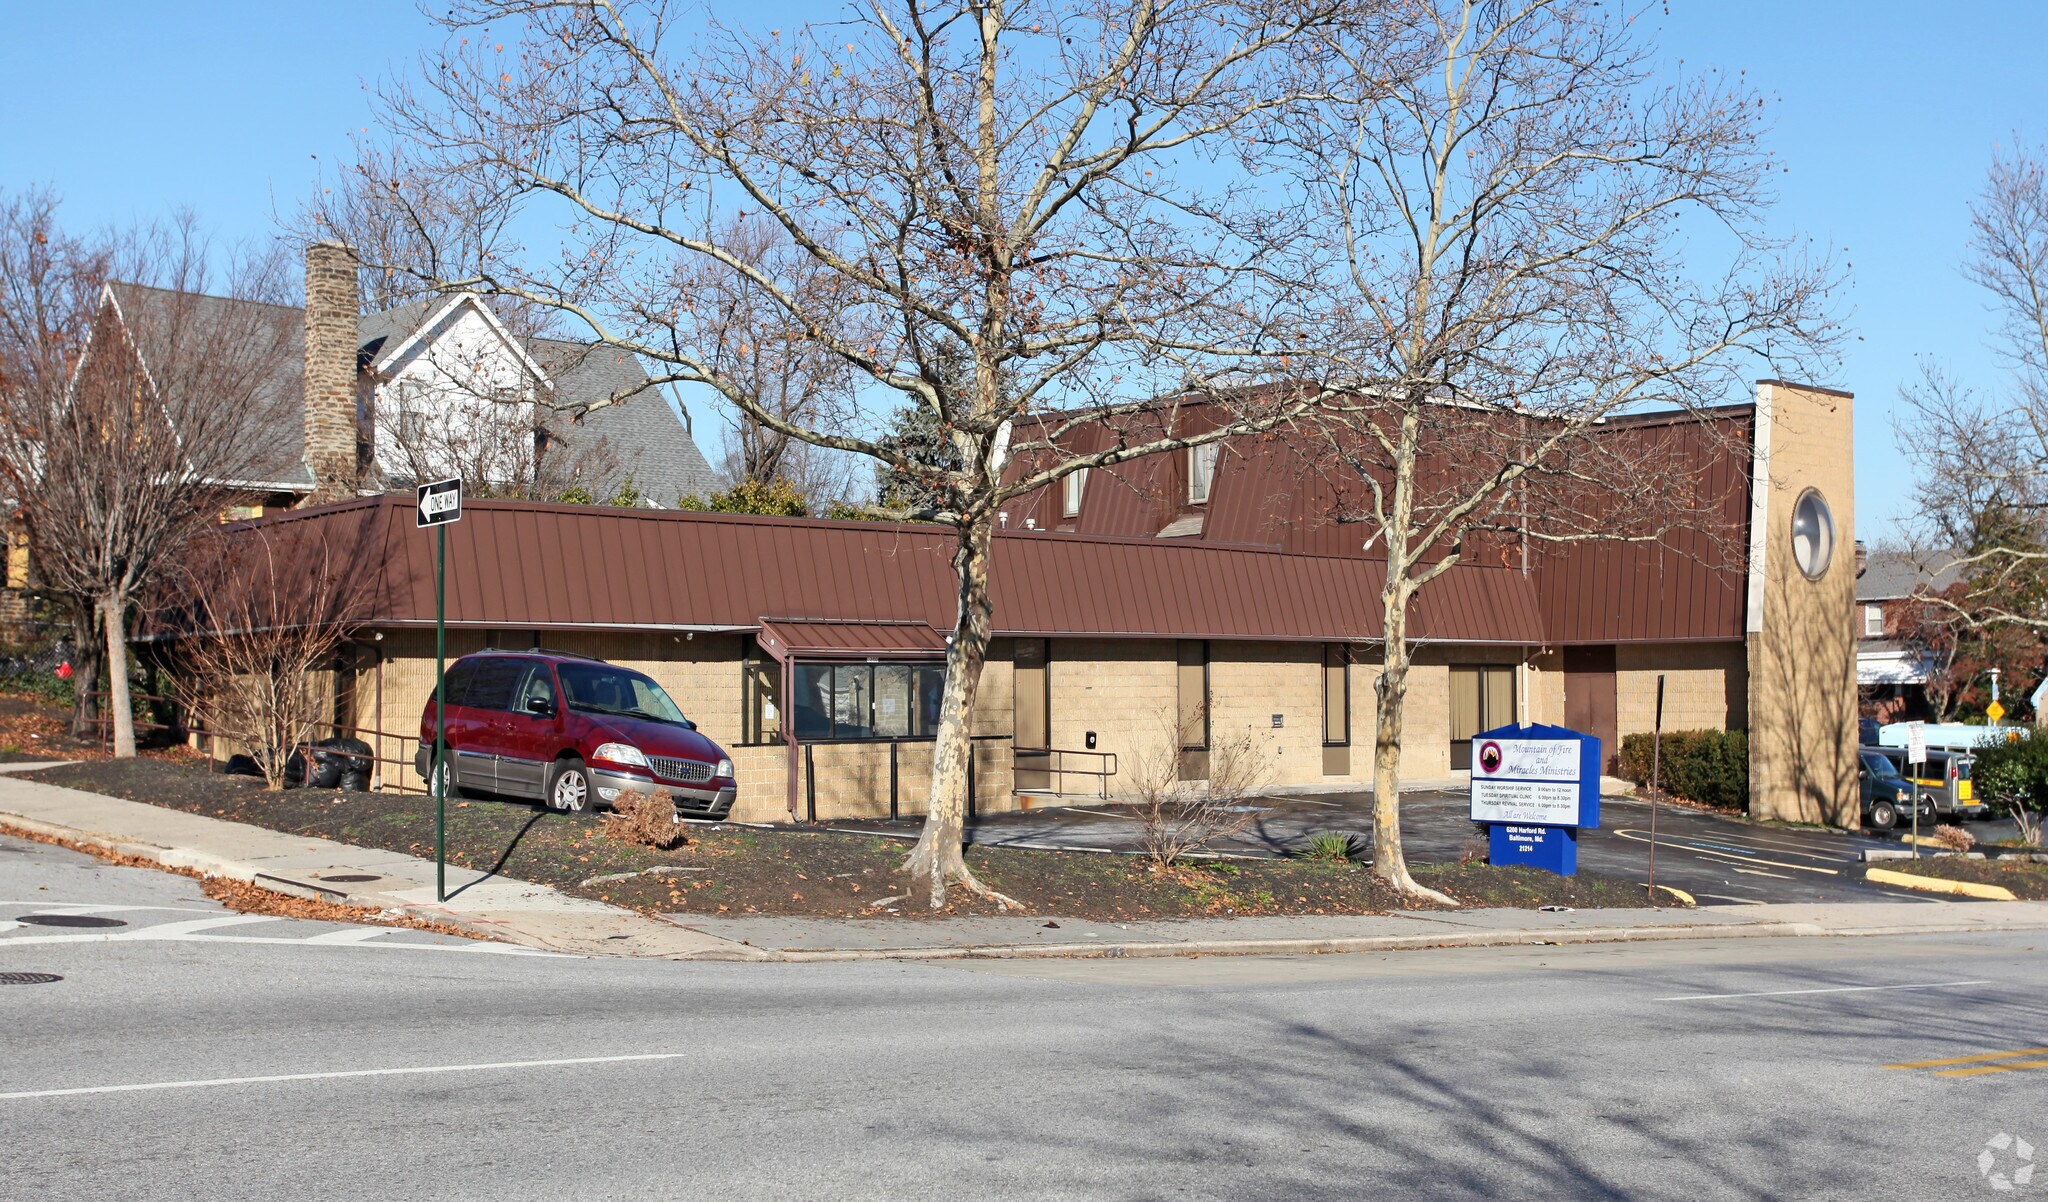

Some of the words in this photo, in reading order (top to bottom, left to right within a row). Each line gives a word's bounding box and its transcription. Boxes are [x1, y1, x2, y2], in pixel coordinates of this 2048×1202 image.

[431, 495, 442, 511] ONE
[444, 490, 456, 509] WAY
[1513, 744, 1547, 754] Mountain
[1549, 744, 1557, 757] of
[1557, 745, 1572, 755] Fire
[1535, 755, 1549, 764] and
[1508, 765, 1538, 775] Miracles
[1540, 765, 1576, 776] Ministries
[1523, 811, 1547, 821] Welcome
[1508, 834, 1534, 843] Baltimore,
[1534, 835, 1544, 843] Md.
